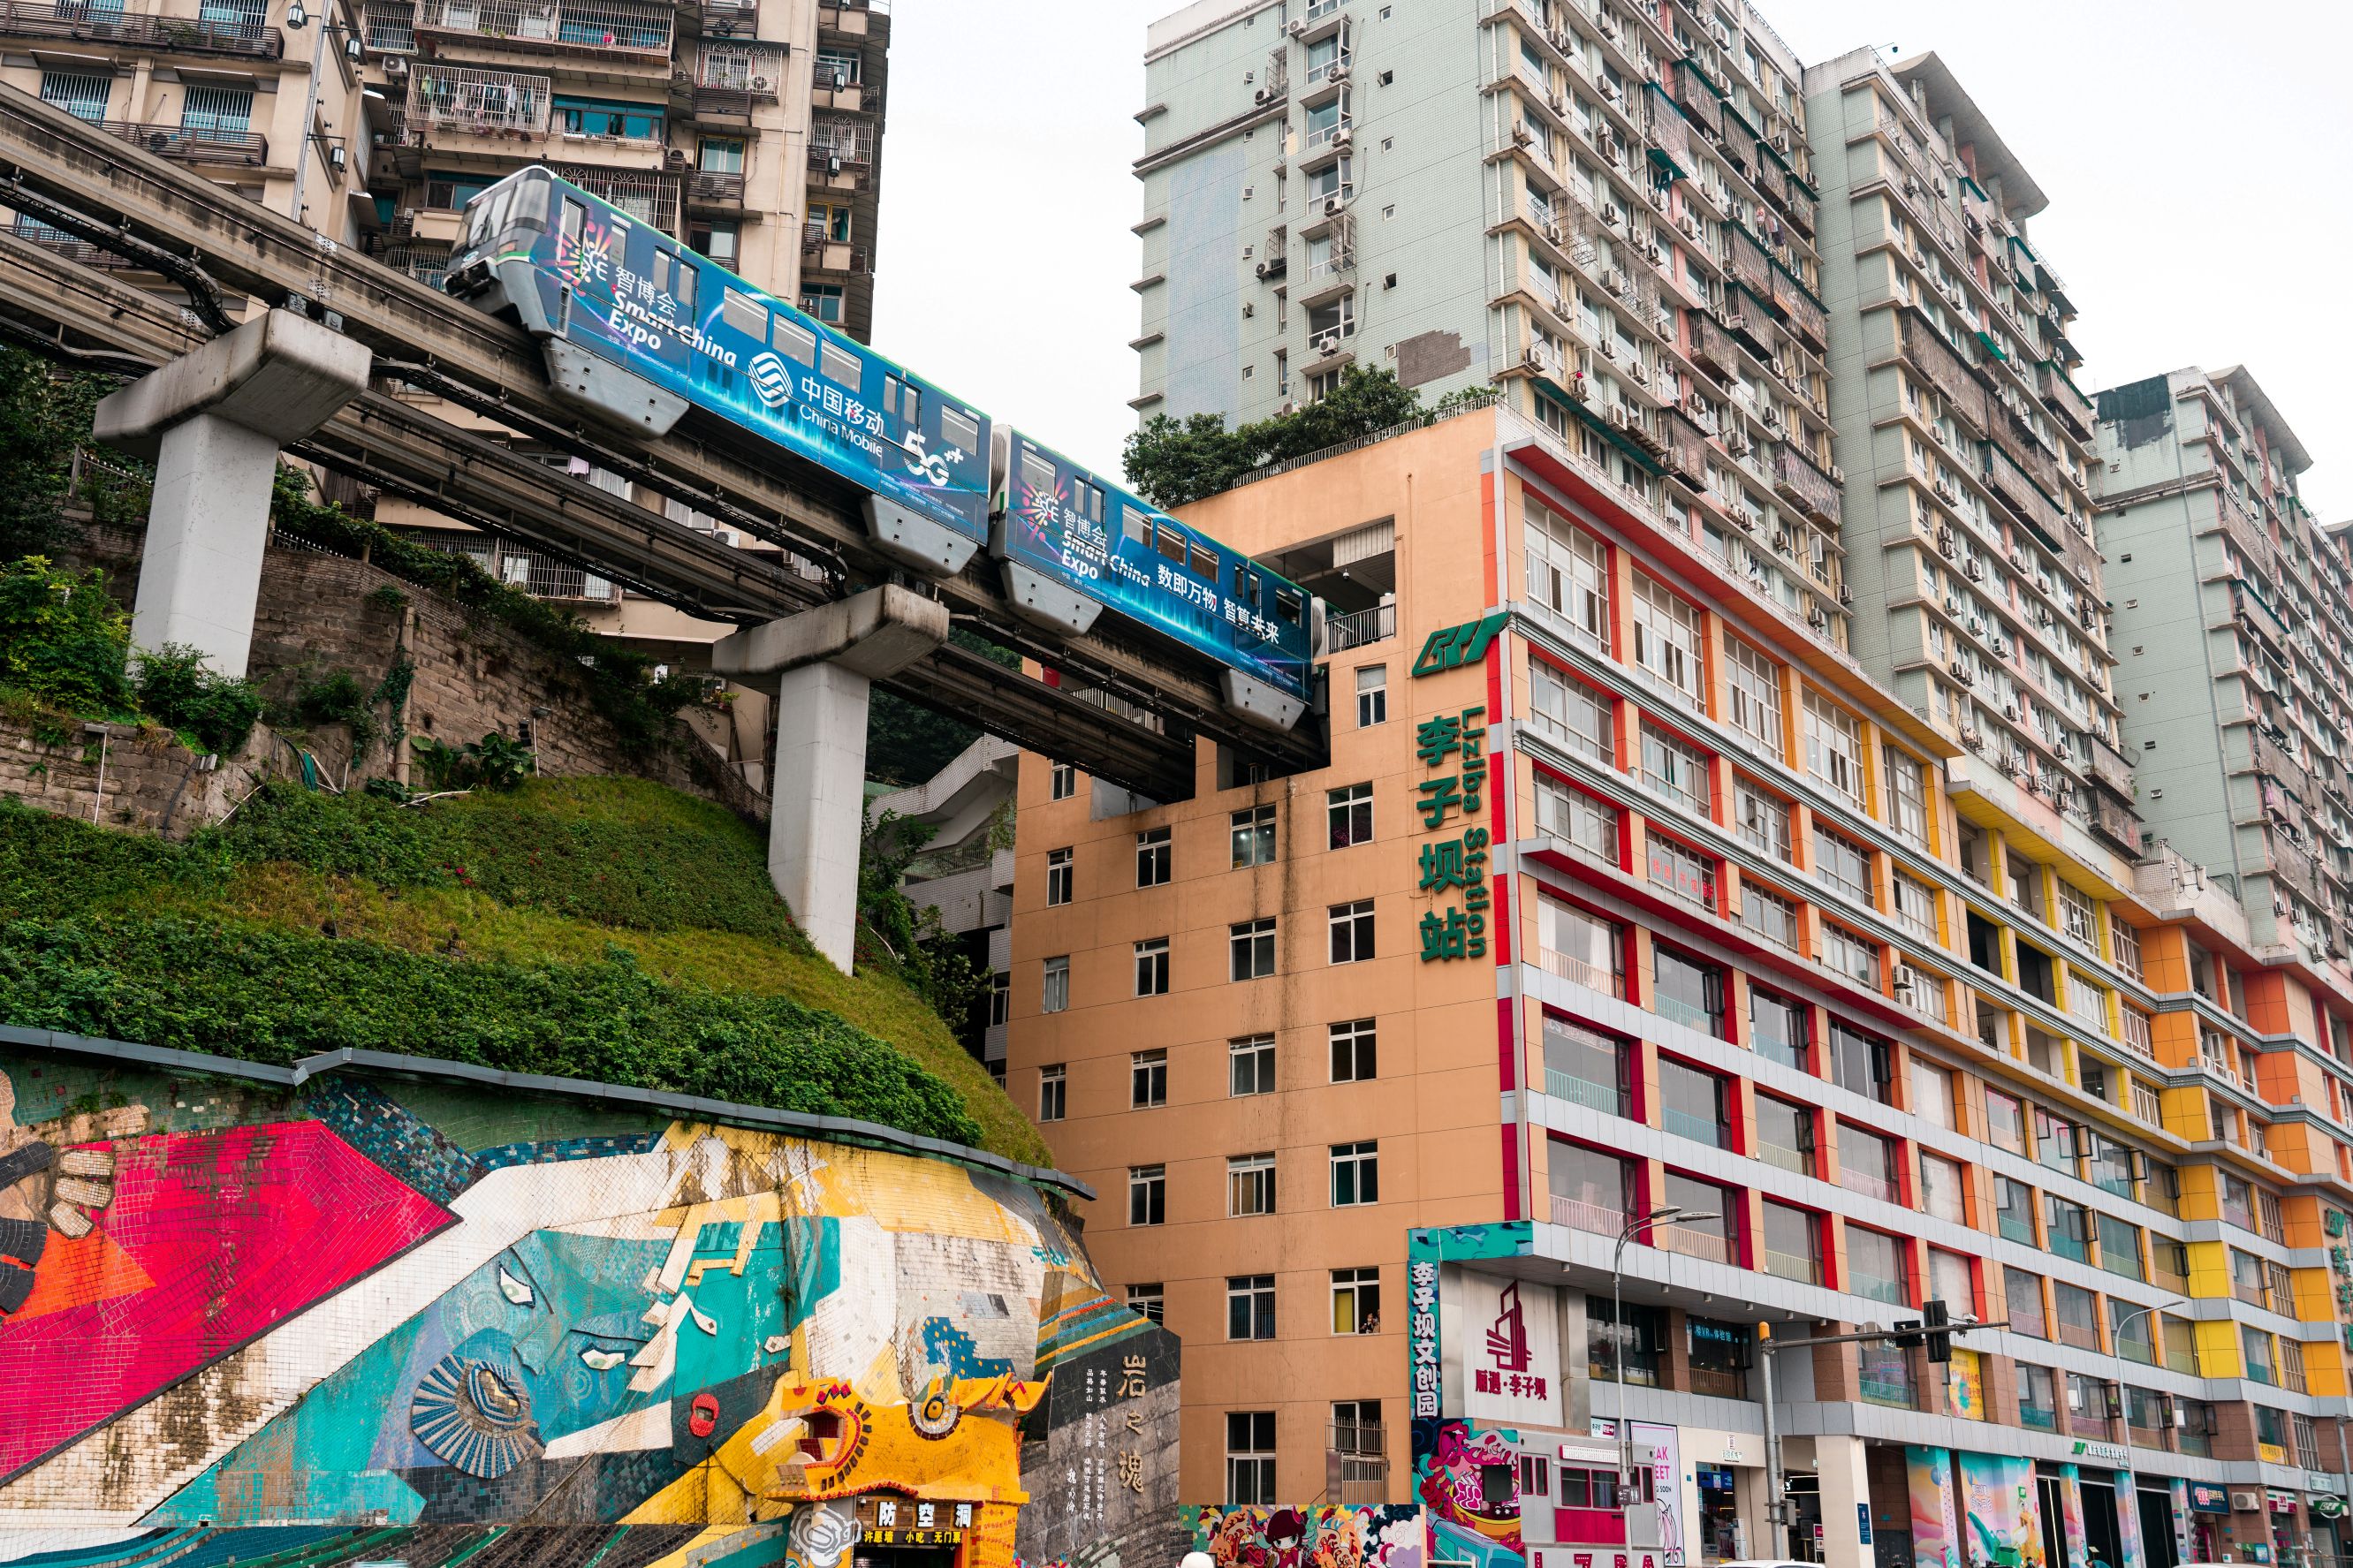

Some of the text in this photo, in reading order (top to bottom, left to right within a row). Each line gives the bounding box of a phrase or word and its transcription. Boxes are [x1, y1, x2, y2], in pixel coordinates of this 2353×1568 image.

[616, 266, 677, 317] 智博会
[609, 309, 661, 350] Expo
[611, 292, 737, 367] Smart China
[800, 404, 883, 458] China Mobile
[801, 376, 884, 437] 中国移动
[1064, 508, 1107, 547] 智博会
[1062, 530, 1150, 587] Smart China
[1062, 548, 1098, 579] Expo
[1158, 564, 1279, 644] 数即万物 智算未来
[1416, 716, 1466, 961] 李子坝站
[1462, 706, 1489, 958] Liziba Station
[1413, 1261, 1438, 1419] 李子坝文创园
[1116, 1354, 1146, 1493] 岩之魂
[864, 1531, 961, 1543] 许愿墙 小吃 无门票
[878, 1502, 972, 1527] 防空洞
